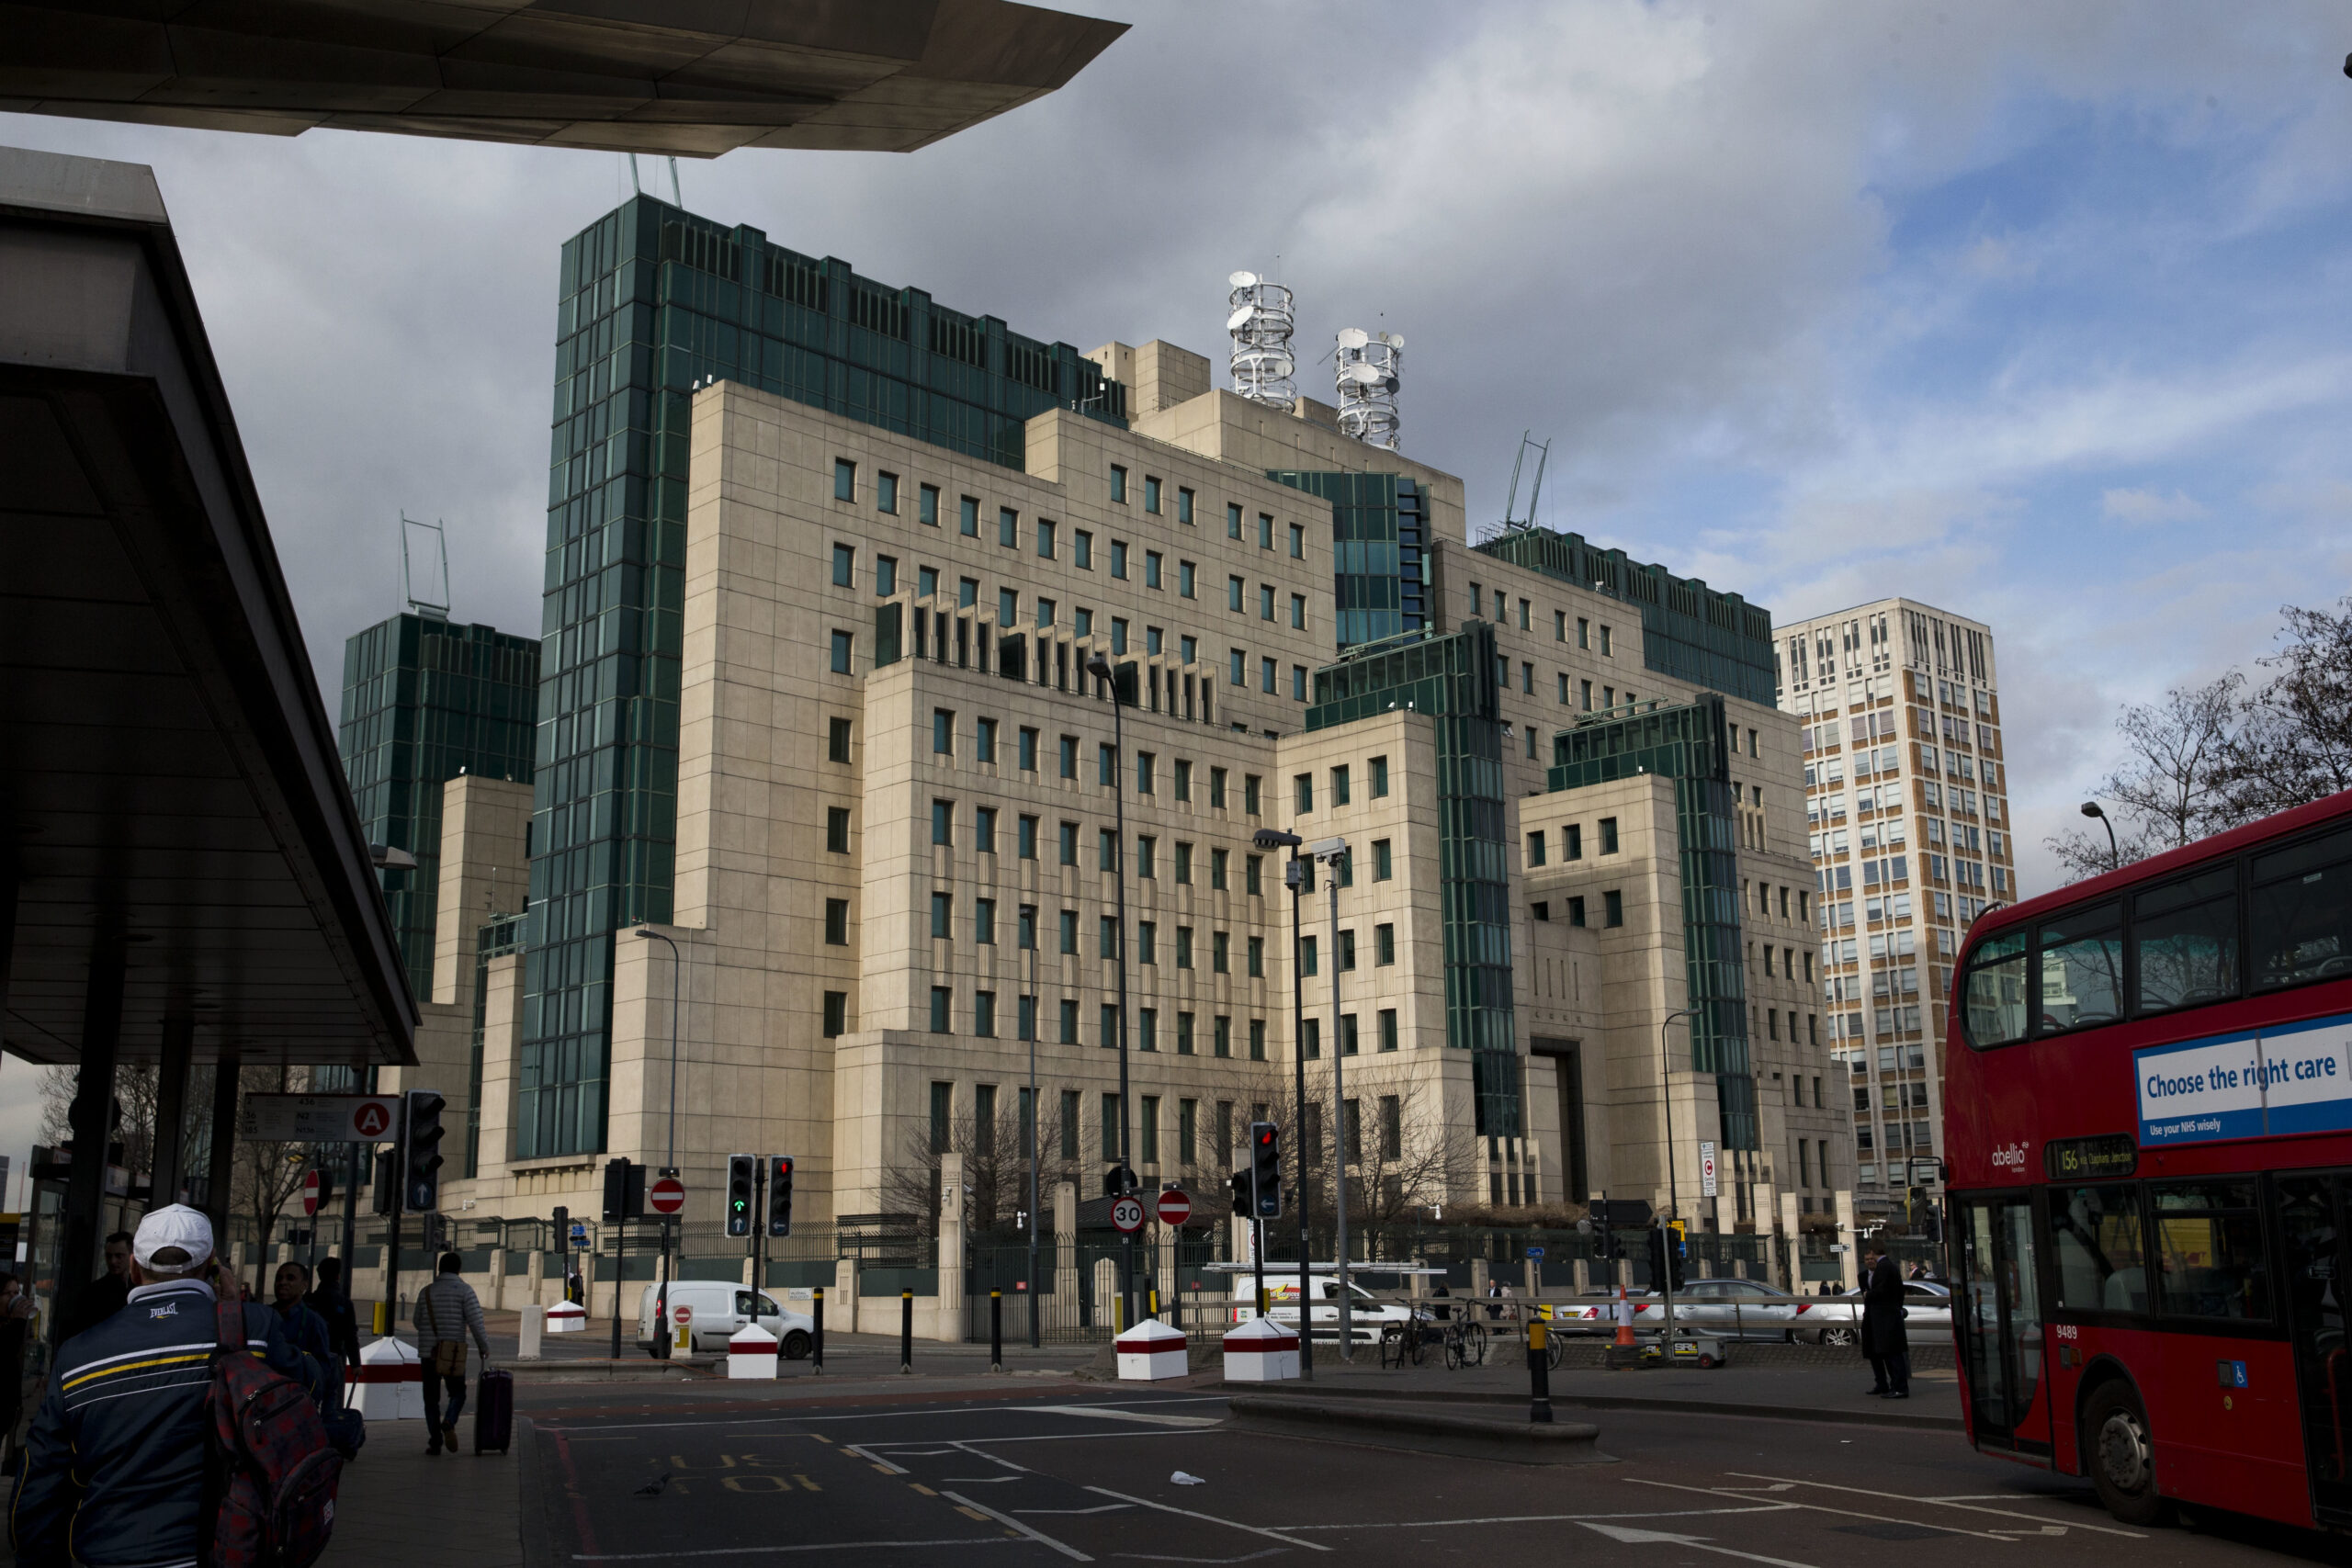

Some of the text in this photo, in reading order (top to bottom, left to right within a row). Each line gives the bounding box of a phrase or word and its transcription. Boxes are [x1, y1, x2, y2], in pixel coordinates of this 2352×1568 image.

[2147, 1056, 2336, 1099] Choose the right care
[360, 1108, 382, 1131] A
[2150, 1118, 2222, 1138] Use your NHS wisely
[1992, 1143, 2025, 1167] abellio
[2062, 1149, 2078, 1171] 156
[1115, 1207, 1140, 1222] 30
[150, 1303, 179, 1318] EVERLAST
[2057, 1325, 2077, 1339] 9489
